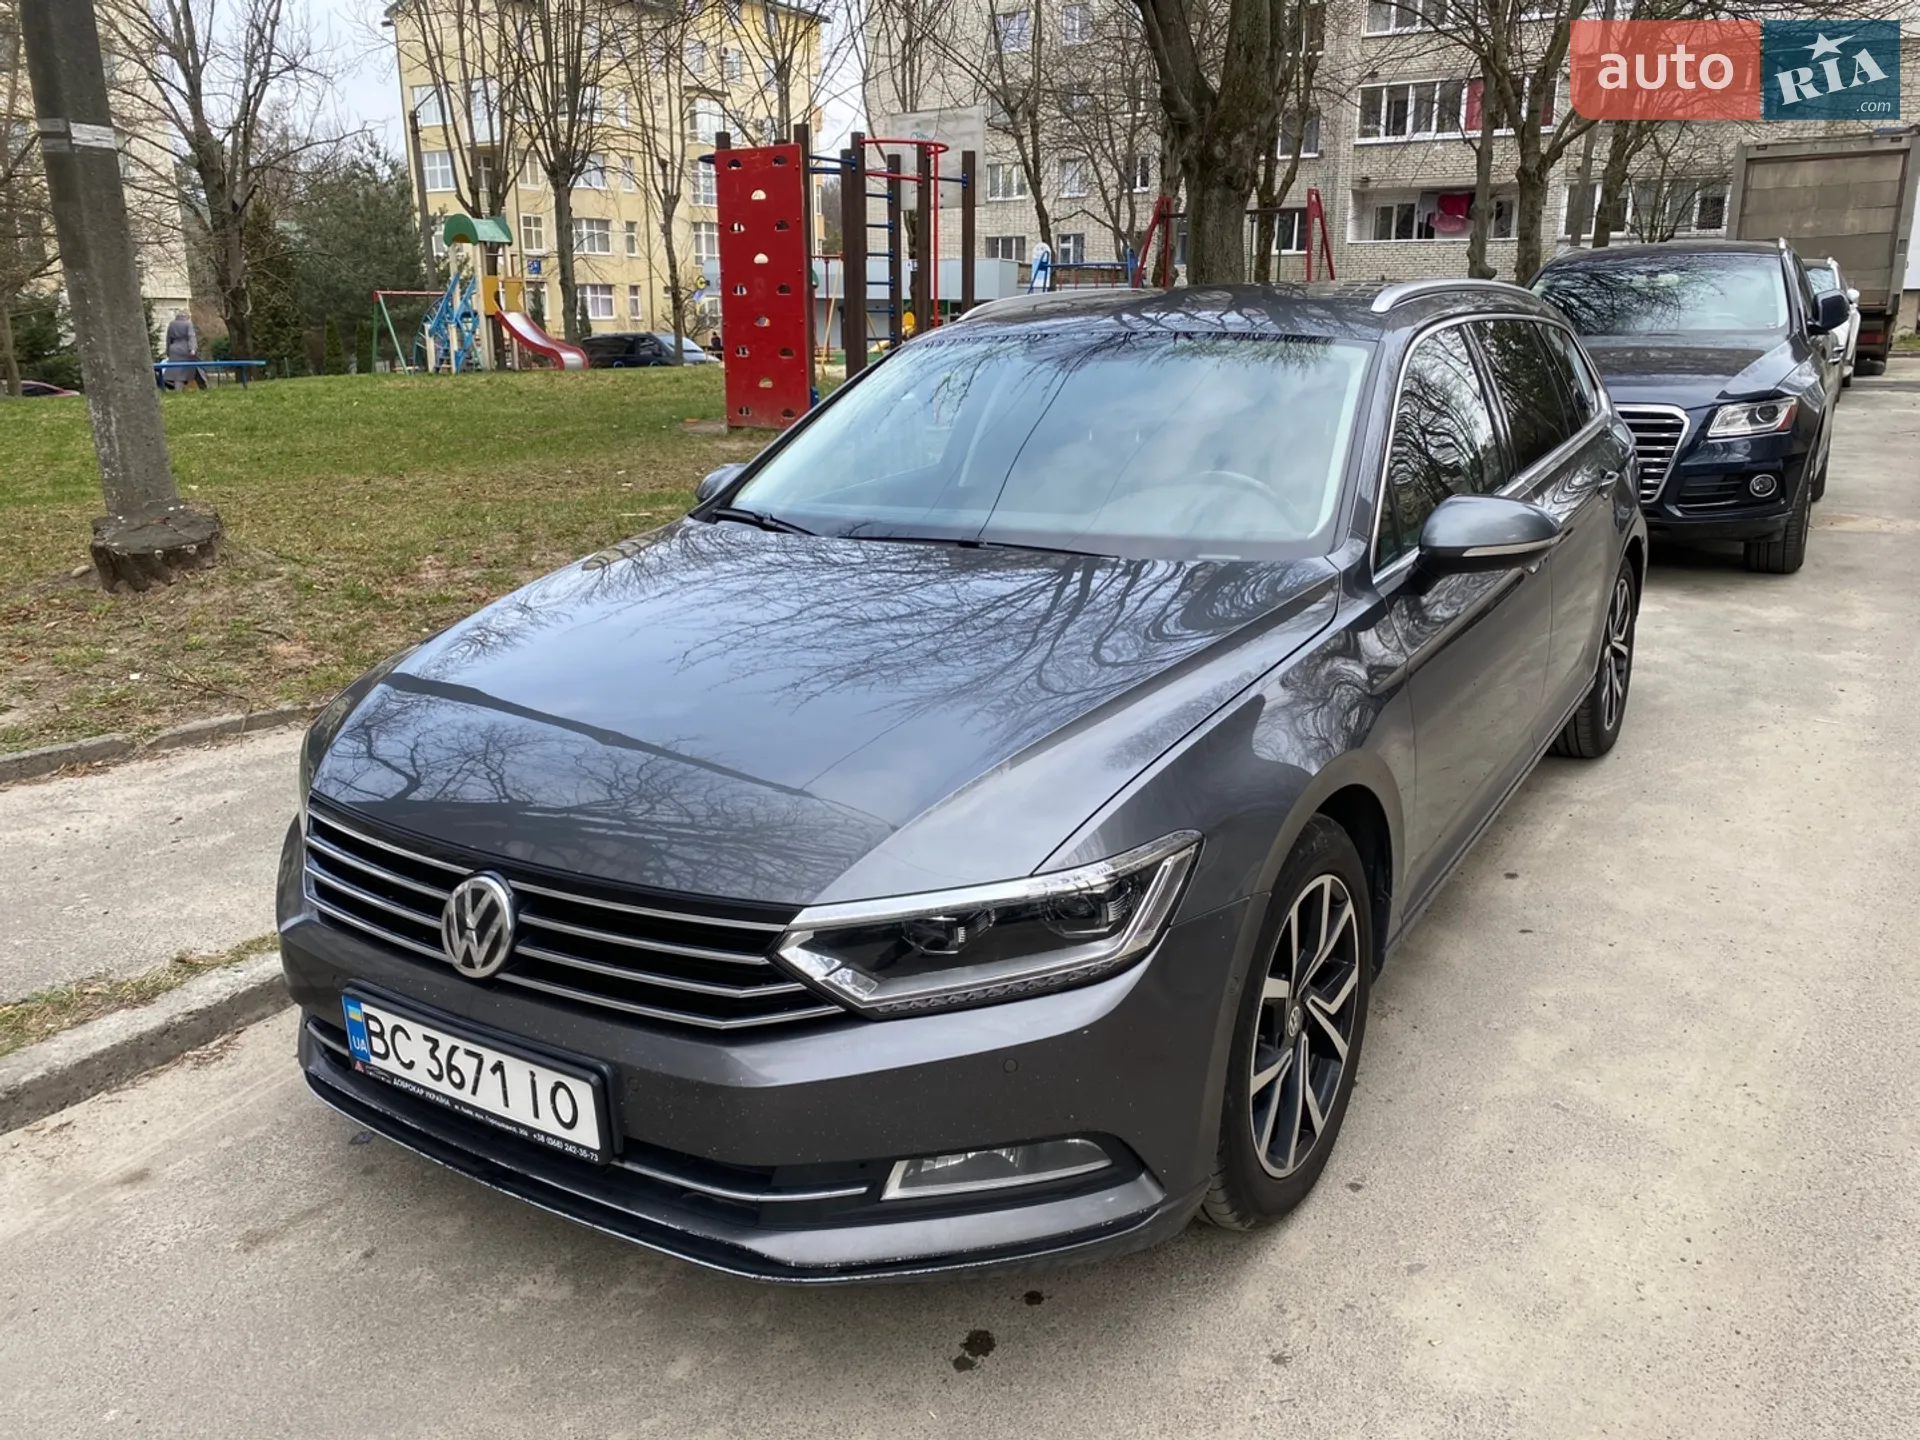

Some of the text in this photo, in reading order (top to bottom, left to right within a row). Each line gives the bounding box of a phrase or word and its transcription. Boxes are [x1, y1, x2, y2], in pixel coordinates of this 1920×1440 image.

[352, 1035, 368, 1054] UA
[362, 1011, 578, 1130] BC 3671 IO
[564, 1143, 599, 1162] 242-35-73
